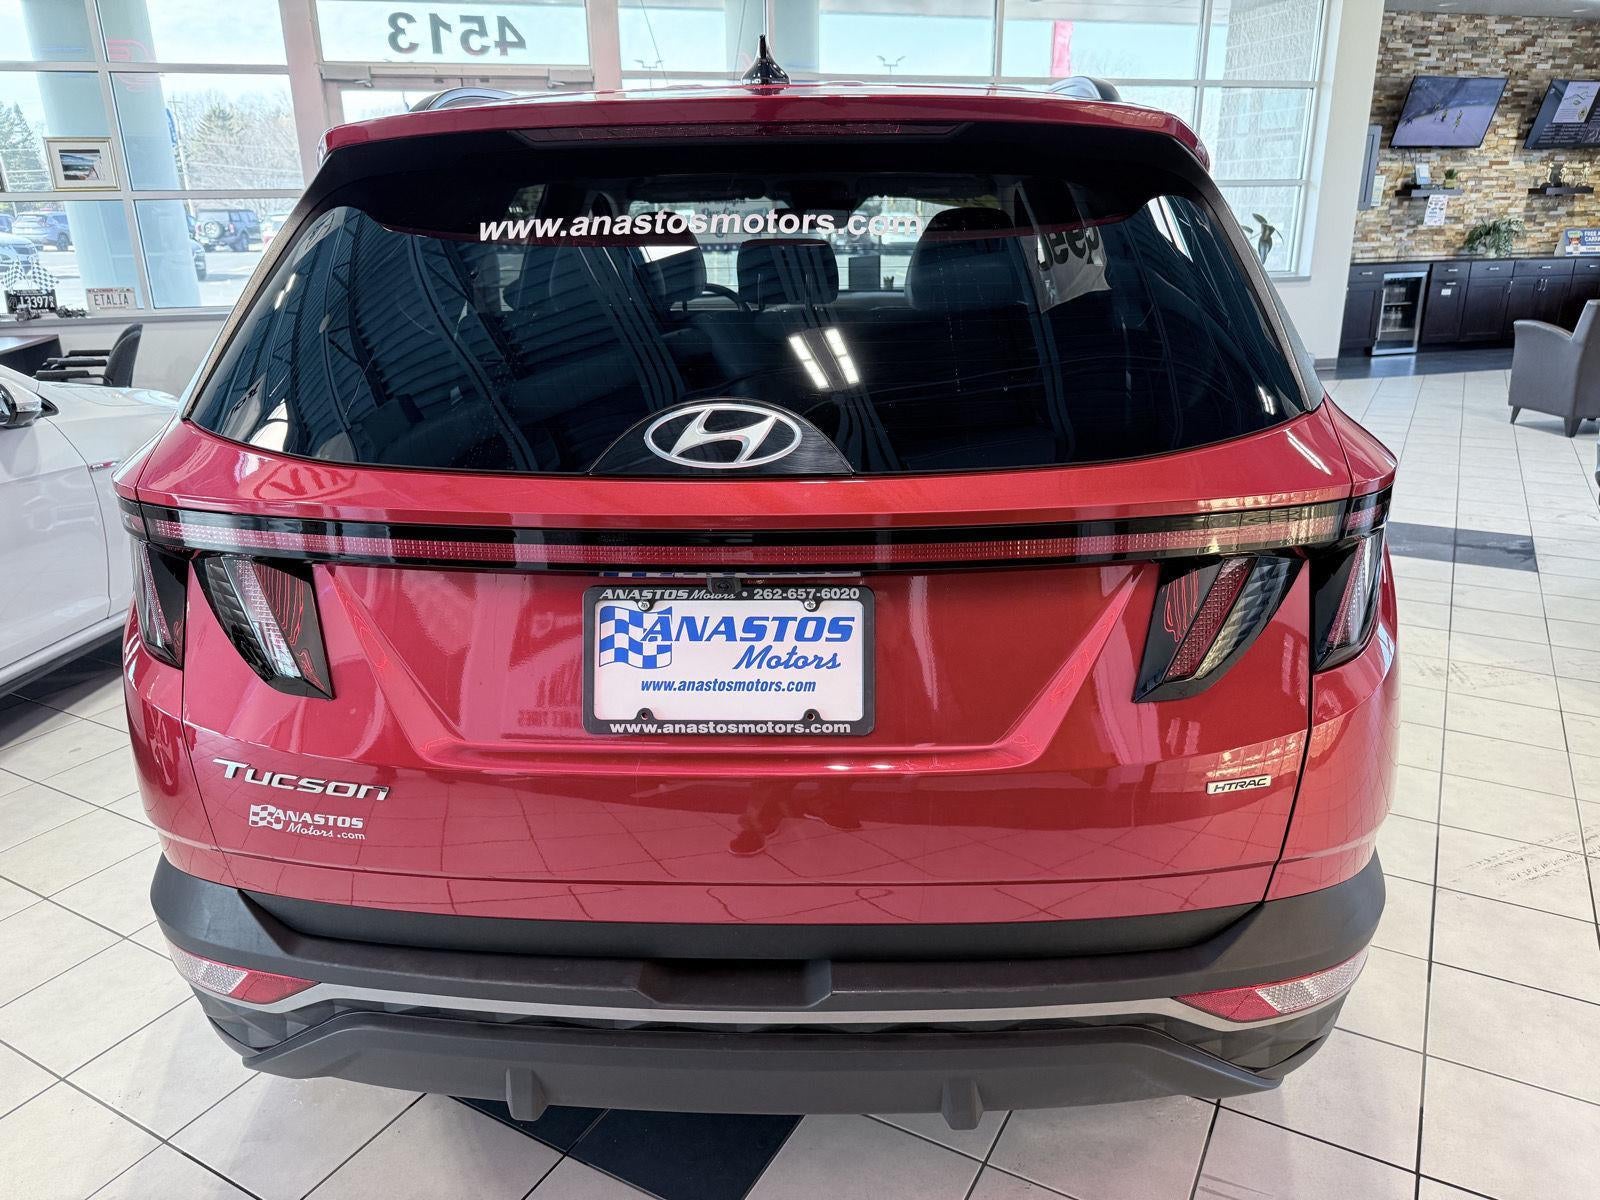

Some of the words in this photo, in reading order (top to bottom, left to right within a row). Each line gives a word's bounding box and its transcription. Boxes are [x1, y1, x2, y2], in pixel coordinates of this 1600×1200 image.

[478, 207, 924, 242] www.anastosmotors.com
[93, 293, 129, 306] ETALIA
[598, 589, 689, 601] ANASTOS
[754, 588, 860, 601] 262-657-6020
[640, 615, 856, 642] ANASTOS
[732, 644, 842, 670] Motors
[640, 679, 818, 693] www.anastosmotors.com
[609, 721, 851, 734] www.anastosmotors.com
[1213, 777, 1267, 793] HTRAC
[272, 808, 364, 829] ANASTOS
[286, 823, 334, 839] Motors
